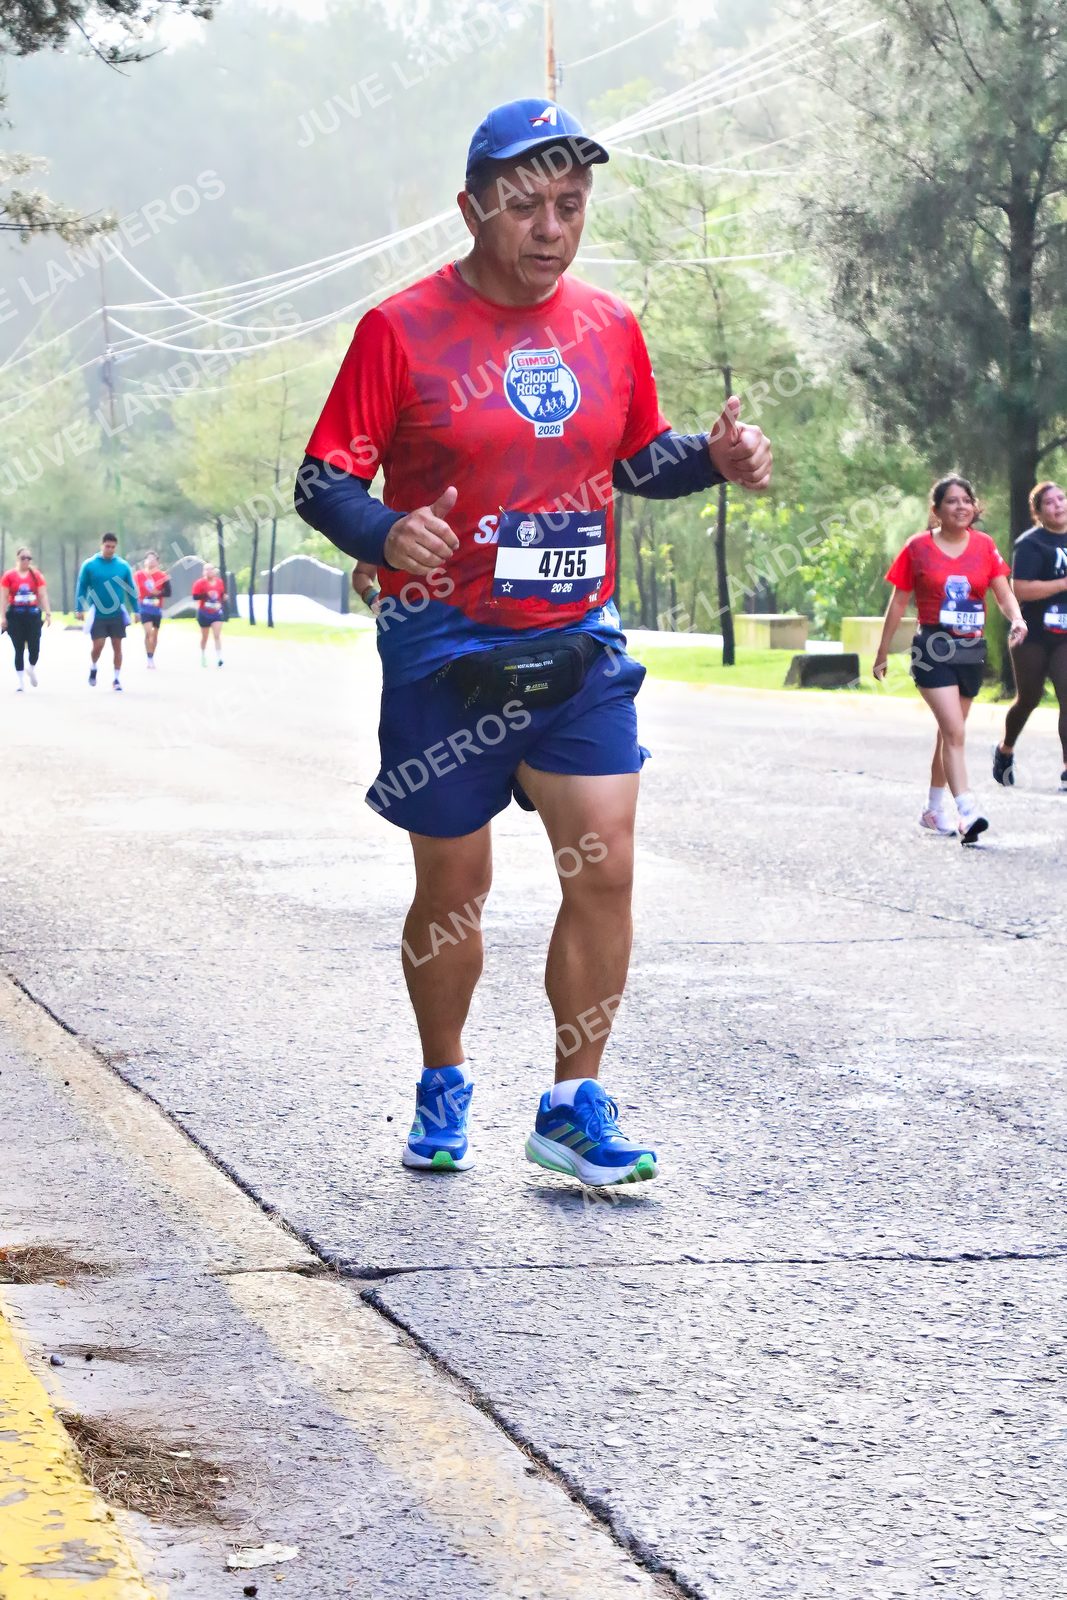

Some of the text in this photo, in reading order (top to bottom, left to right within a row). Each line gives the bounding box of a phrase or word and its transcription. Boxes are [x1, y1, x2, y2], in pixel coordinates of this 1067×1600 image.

[517, 356, 556, 367] BIMBO
[521, 369, 559, 384] Global
[516, 383, 547, 396] Race
[537, 425, 561, 435] 2026
[538, 549, 588, 578] 4755
